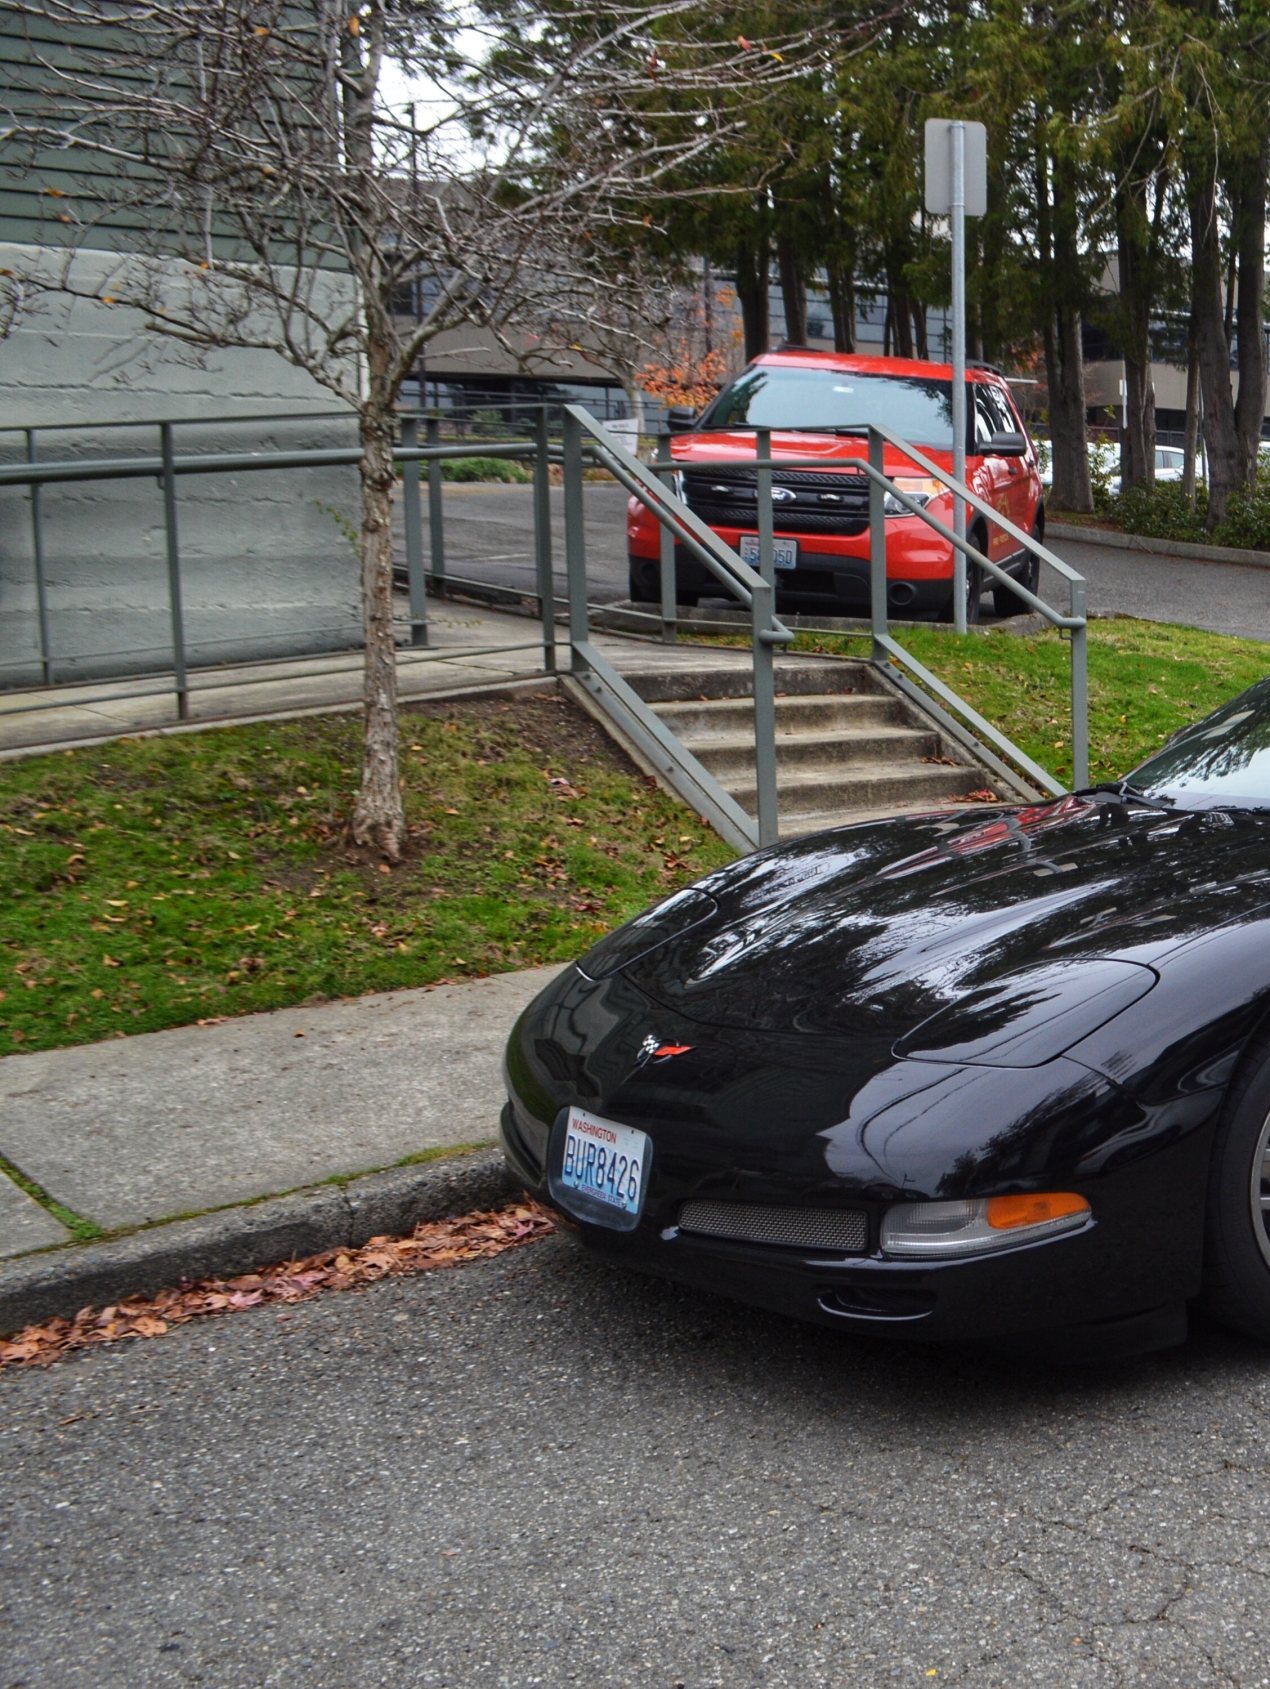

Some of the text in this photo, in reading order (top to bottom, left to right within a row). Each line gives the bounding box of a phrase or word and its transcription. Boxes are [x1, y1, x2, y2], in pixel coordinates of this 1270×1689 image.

[572, 1118, 617, 1144] WASHINGTON
[564, 1134, 639, 1201] BUR8426
[581, 1184, 606, 1199] EVERGREEN
